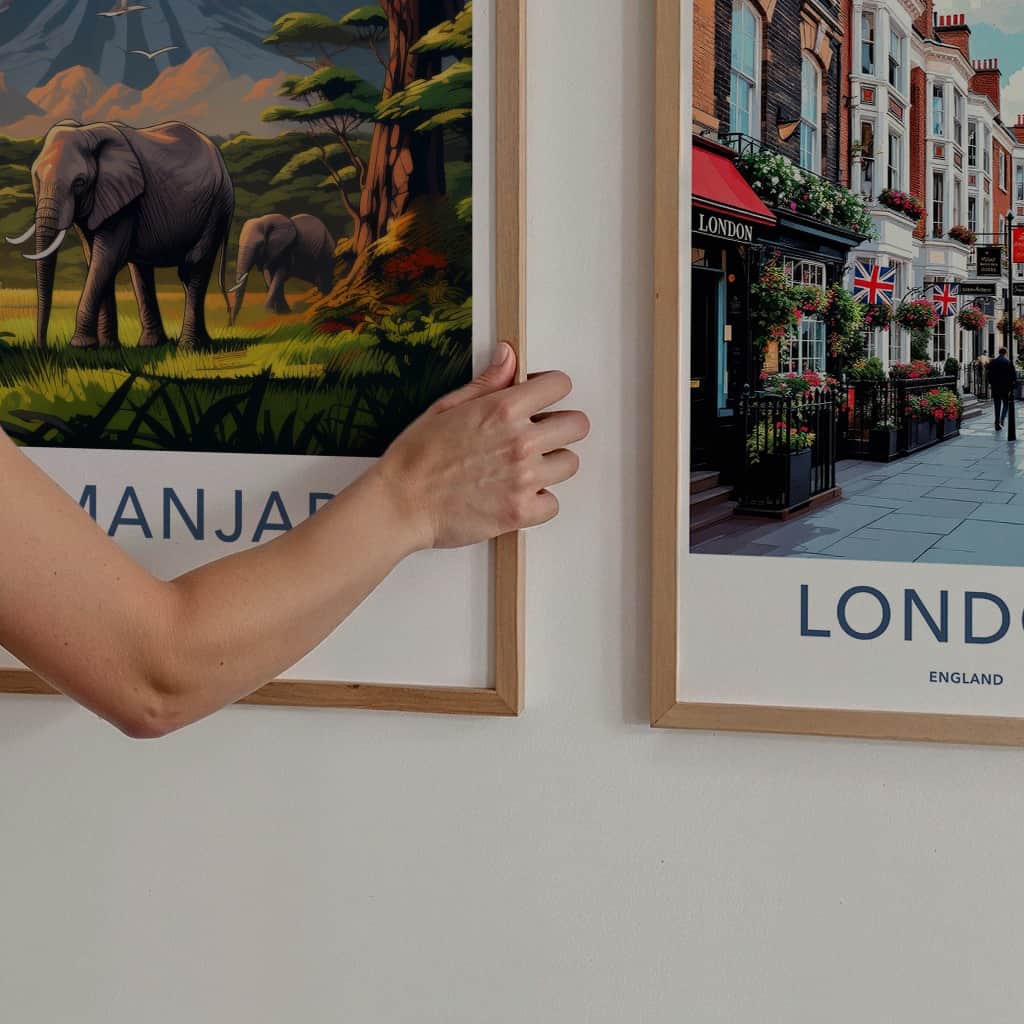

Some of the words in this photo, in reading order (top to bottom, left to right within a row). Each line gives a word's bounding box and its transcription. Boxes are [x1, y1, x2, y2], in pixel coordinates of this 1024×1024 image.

[698, 213, 753, 241] LONDON
[78, 484, 337, 543] ANJA
[800, 584, 1024, 644] LOND
[929, 671, 1003, 685] ENGLAND
